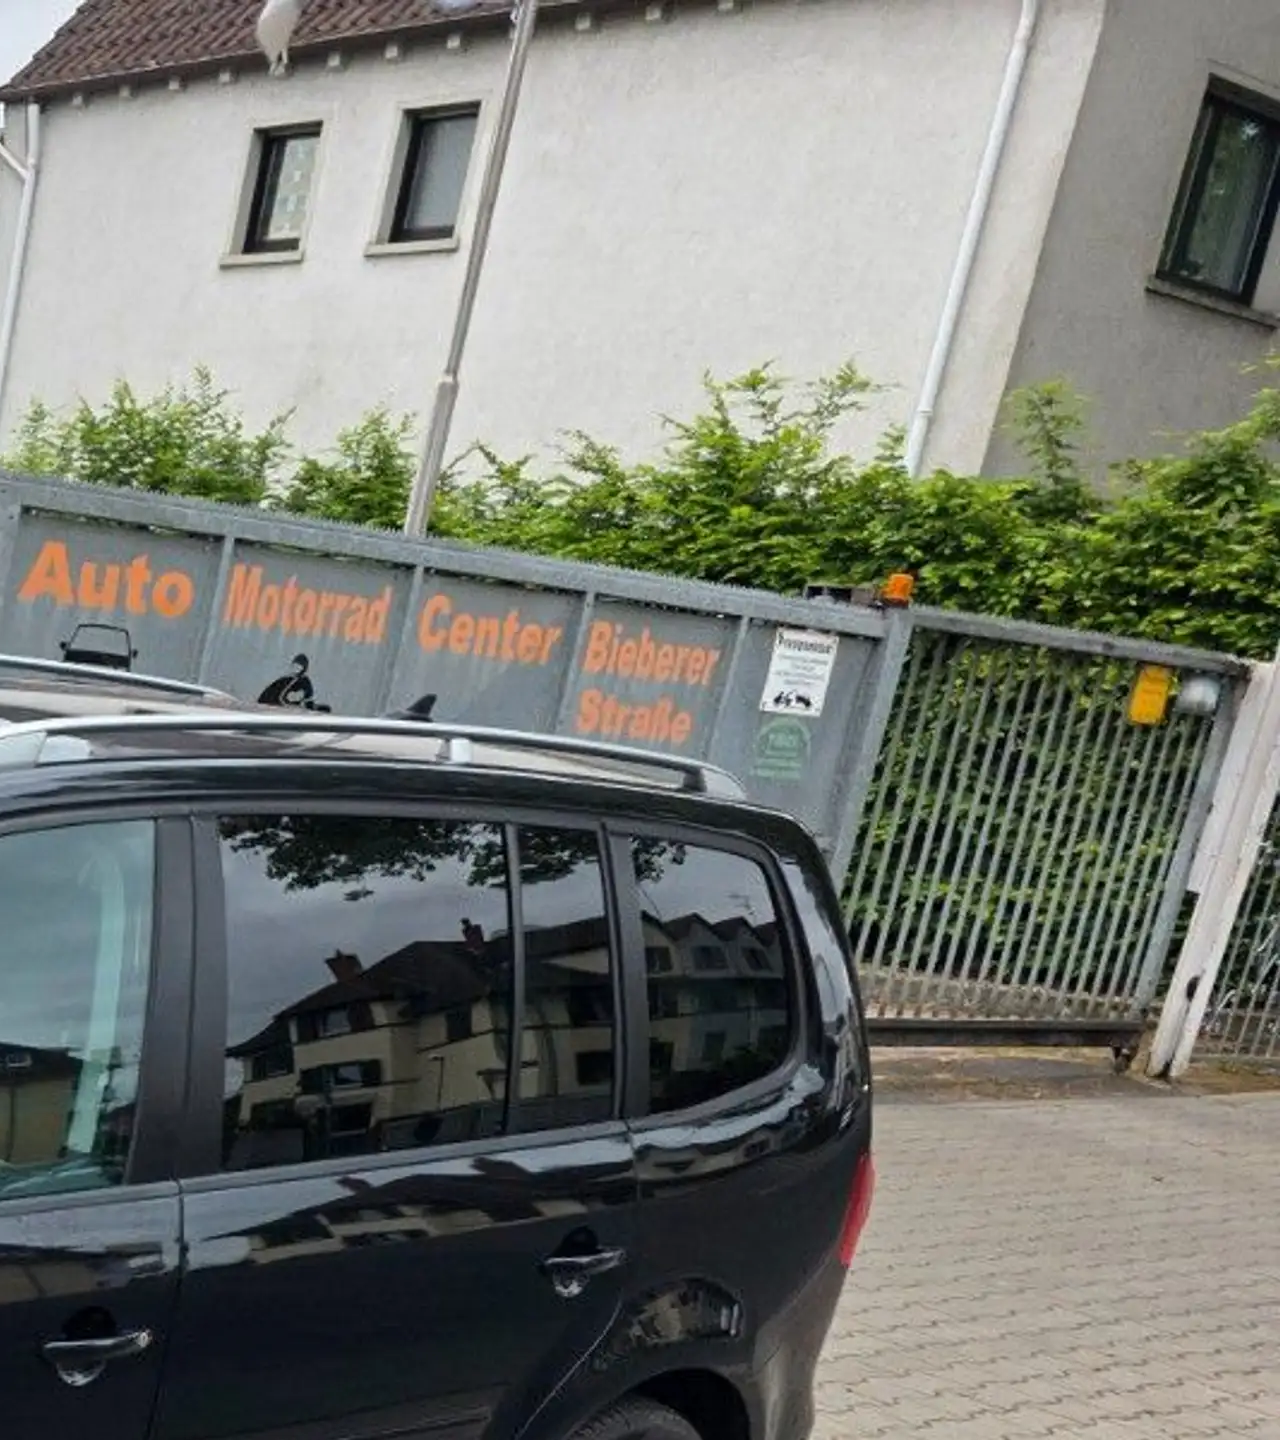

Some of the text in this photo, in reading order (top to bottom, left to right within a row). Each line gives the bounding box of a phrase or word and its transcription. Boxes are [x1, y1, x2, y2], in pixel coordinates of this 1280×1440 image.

[16, 539, 195, 618] Auto
[223, 563, 392, 644] Motorrad
[416, 593, 562, 666] Center
[583, 620, 720, 686] Bieberer
[576, 688, 694, 744] Straße
